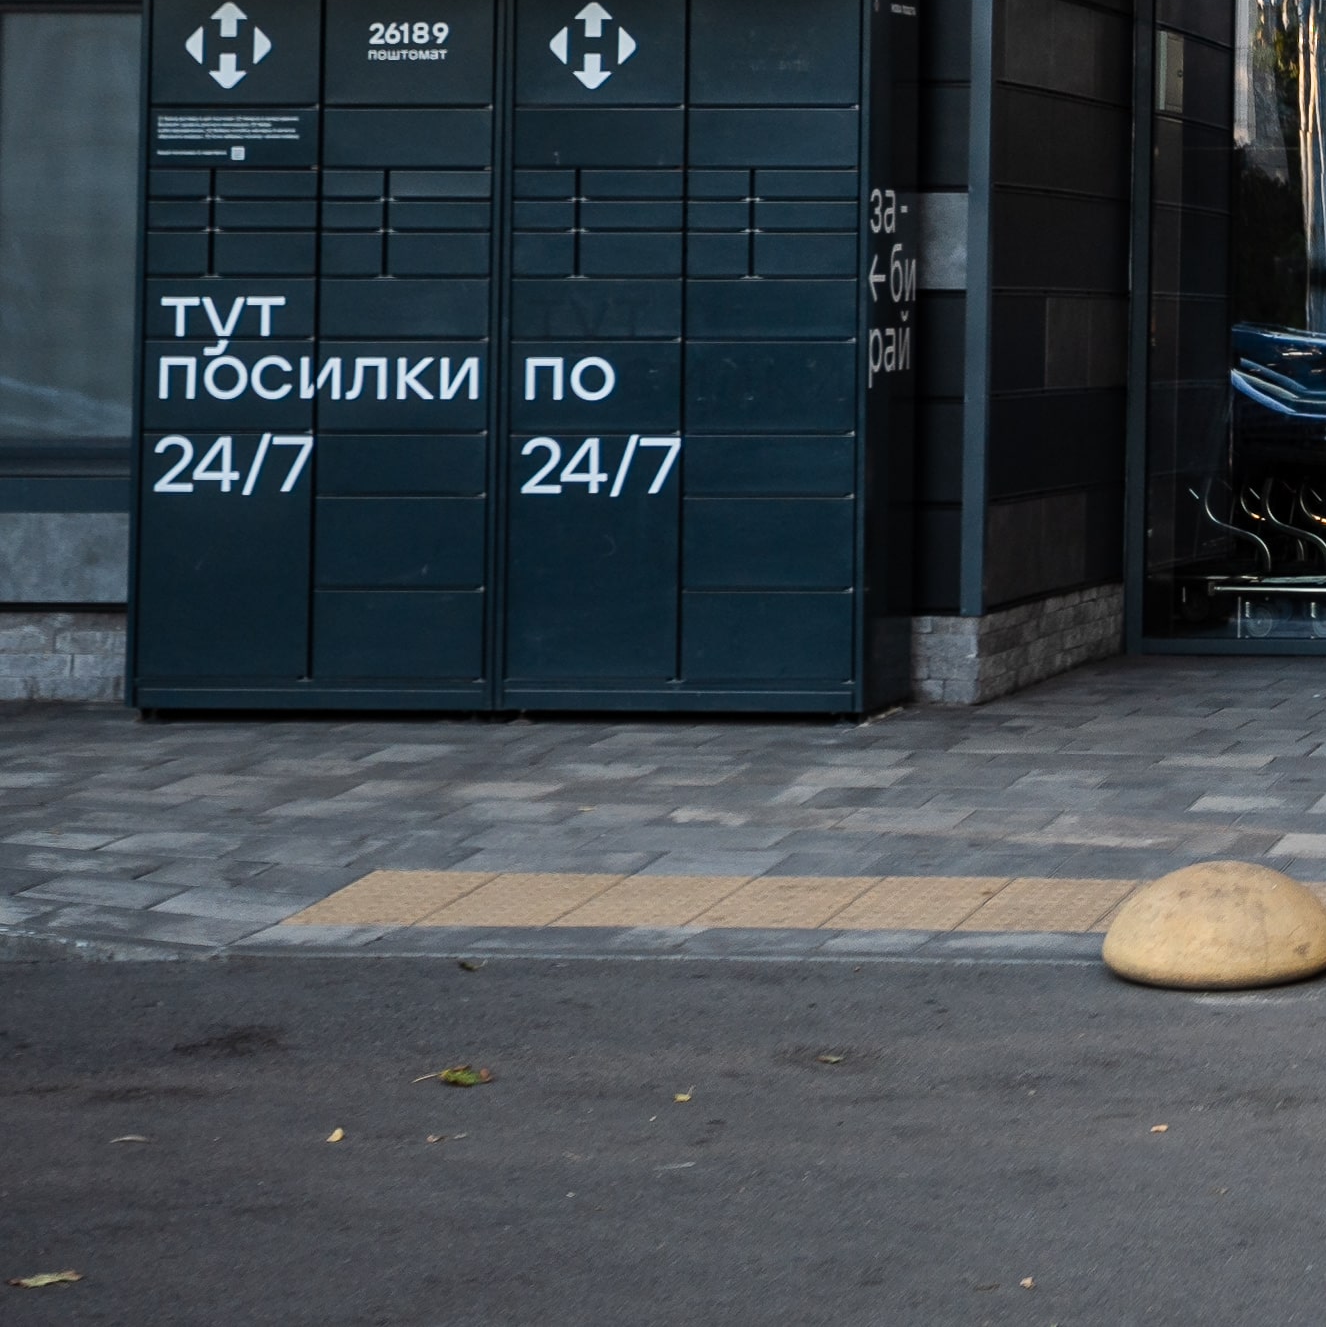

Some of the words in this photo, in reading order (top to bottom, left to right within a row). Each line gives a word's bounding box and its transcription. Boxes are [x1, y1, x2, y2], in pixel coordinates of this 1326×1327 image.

[367, 48, 448, 62] поштомат
[368, 21, 450, 46] 26189
[868, 310, 911, 389] рай
[523, 355, 617, 402] по
[153, 434, 315, 497] 24/7
[520, 435, 683, 498] 24/7
